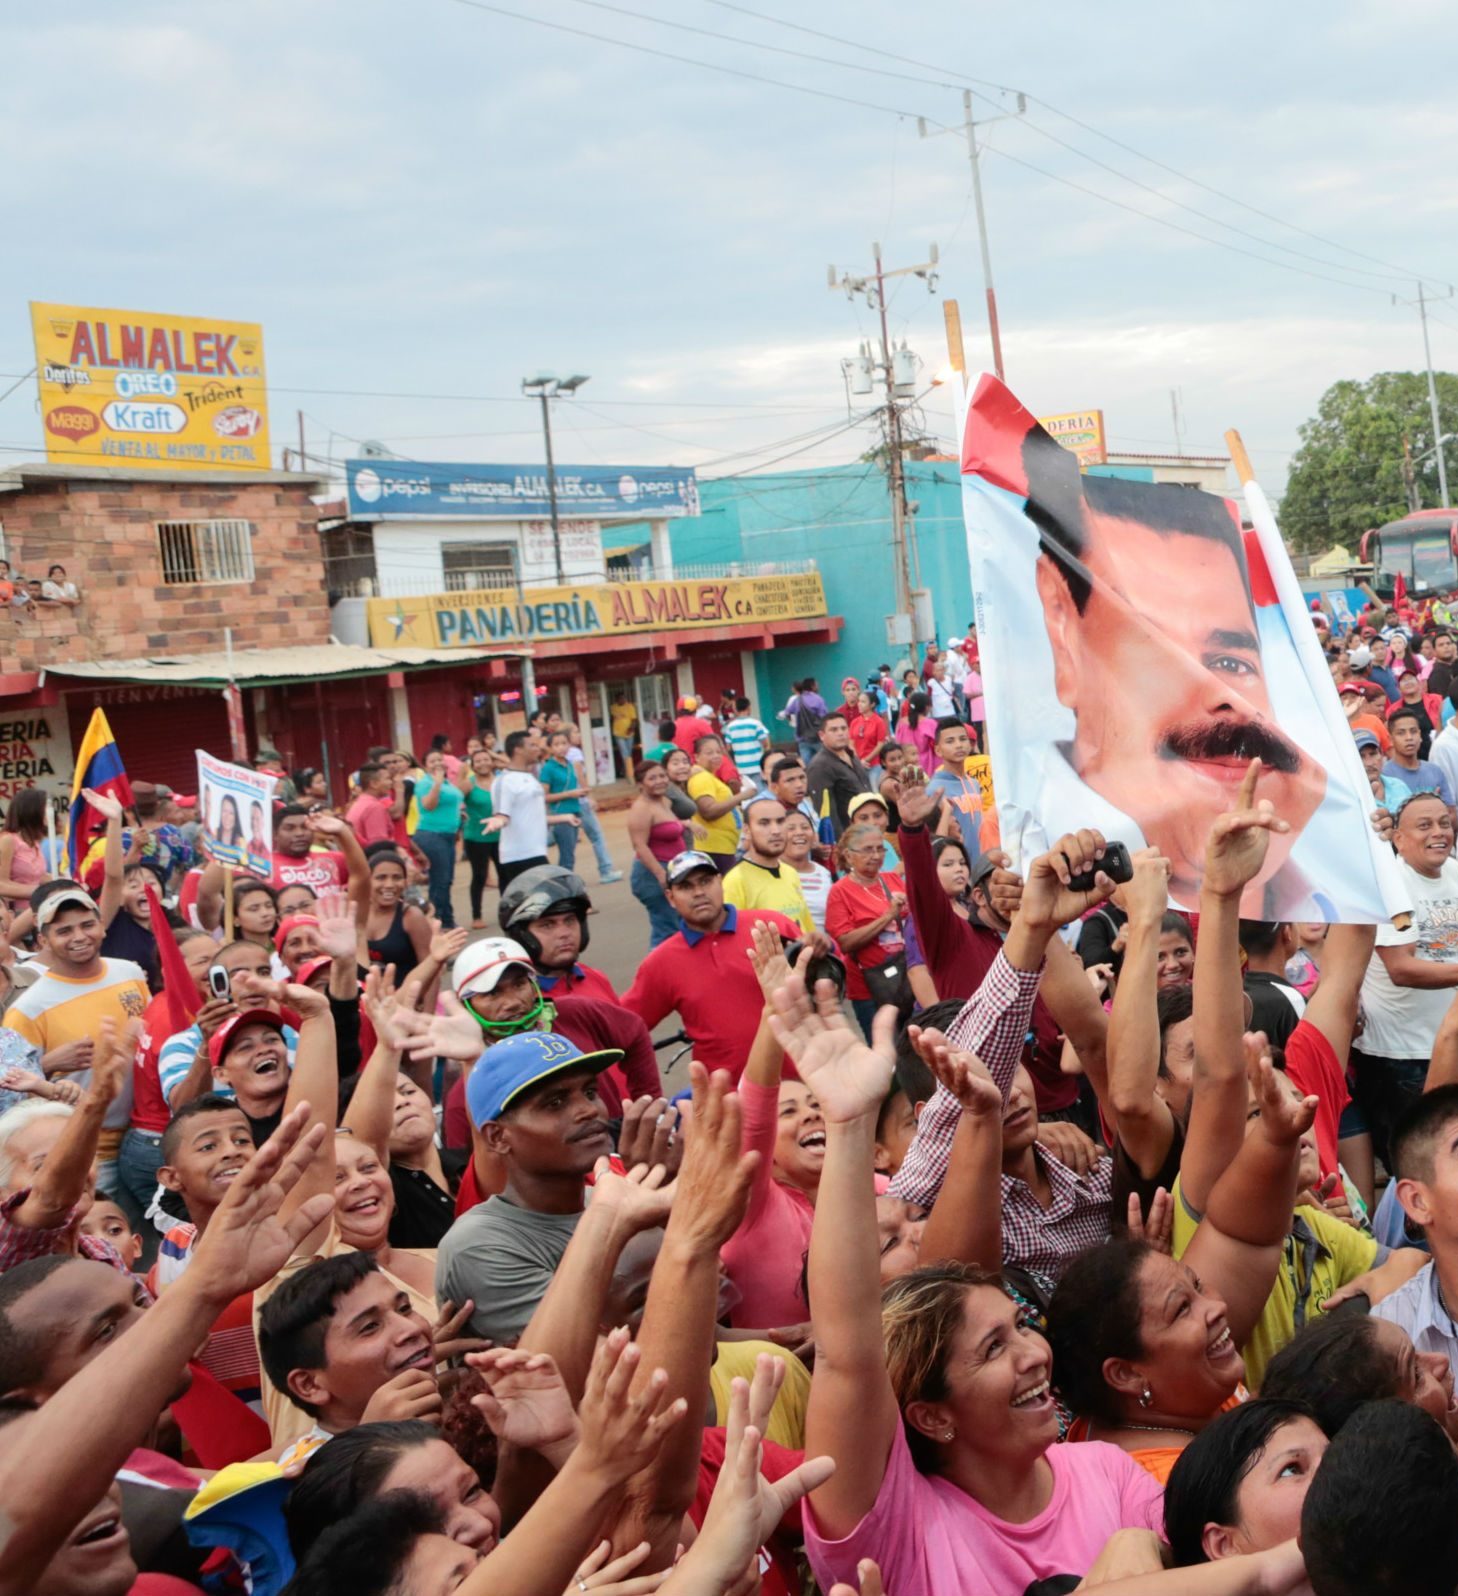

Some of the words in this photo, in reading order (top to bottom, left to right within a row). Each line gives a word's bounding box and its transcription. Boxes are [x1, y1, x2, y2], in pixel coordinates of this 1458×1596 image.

[70, 320, 241, 377] ALMALEK
[44, 366, 92, 385] Doritos
[115, 371, 178, 398] OREO
[184, 385, 244, 412] Trident
[113, 404, 173, 430] Kraft
[145, 442, 162, 459] AL
[166, 443, 207, 459] MAYOR
[382, 477, 431, 498] pepsi
[638, 481, 675, 498] pepsi
[555, 519, 595, 534] ENDE
[611, 584, 732, 627] ALMALEK
